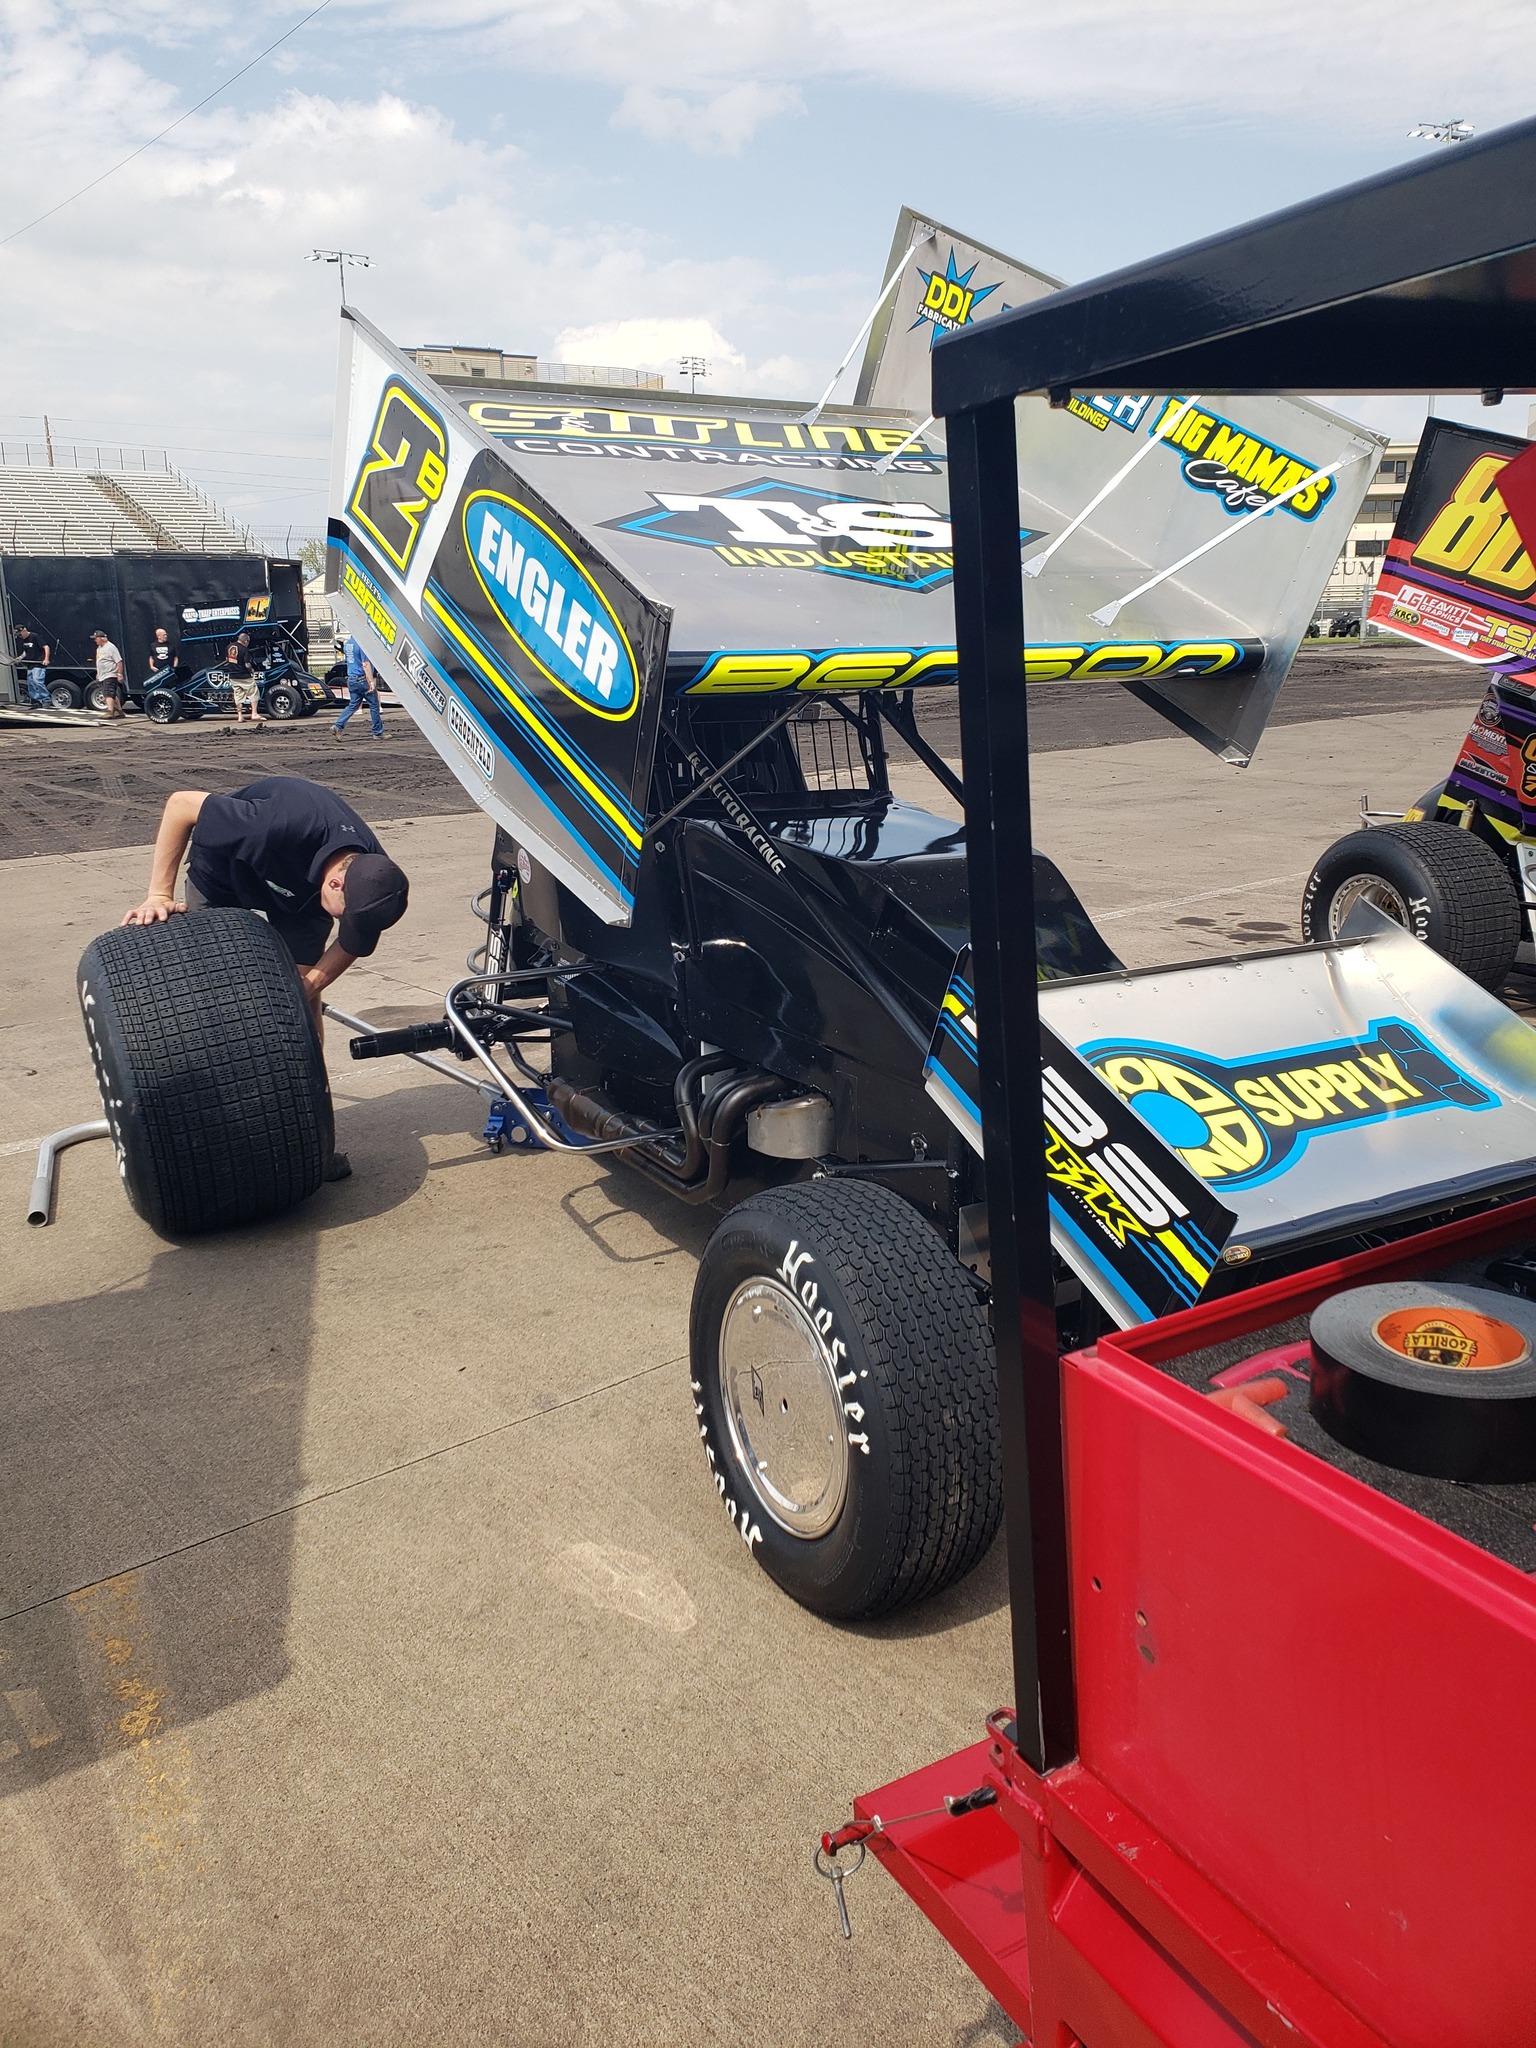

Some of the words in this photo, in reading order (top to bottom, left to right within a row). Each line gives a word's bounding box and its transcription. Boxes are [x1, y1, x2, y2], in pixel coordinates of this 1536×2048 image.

[917, 302, 962, 332] FABRICATI
[925, 274, 974, 324] DDI
[1067, 398, 1110, 430] ILDINGS
[513, 438, 936, 473] CONTRACTING
[1155, 399, 1216, 452] BIG
[1202, 425, 1331, 513] MAMA'S
[1185, 458, 1269, 507] Cafe
[651, 492, 954, 548] T&S
[714, 546, 954, 569] INDUSTRI
[1331, 560, 1375, 577] EUM
[477, 508, 620, 702] ENGLER
[1420, 604, 1463, 624] GRAPHICS
[1421, 595, 1468, 617] LEAVITT
[419, 669, 447, 708] KEIZER
[450, 706, 493, 773] SCHOENFELD
[735, 813, 787, 876] RACING
[1233, 1053, 1424, 1127] SUPPLY
[1066, 1185, 1097, 1218] FACTORY
[776, 1239, 870, 1455] Hoosier
[1411, 1334, 1468, 1351] GORILLA
